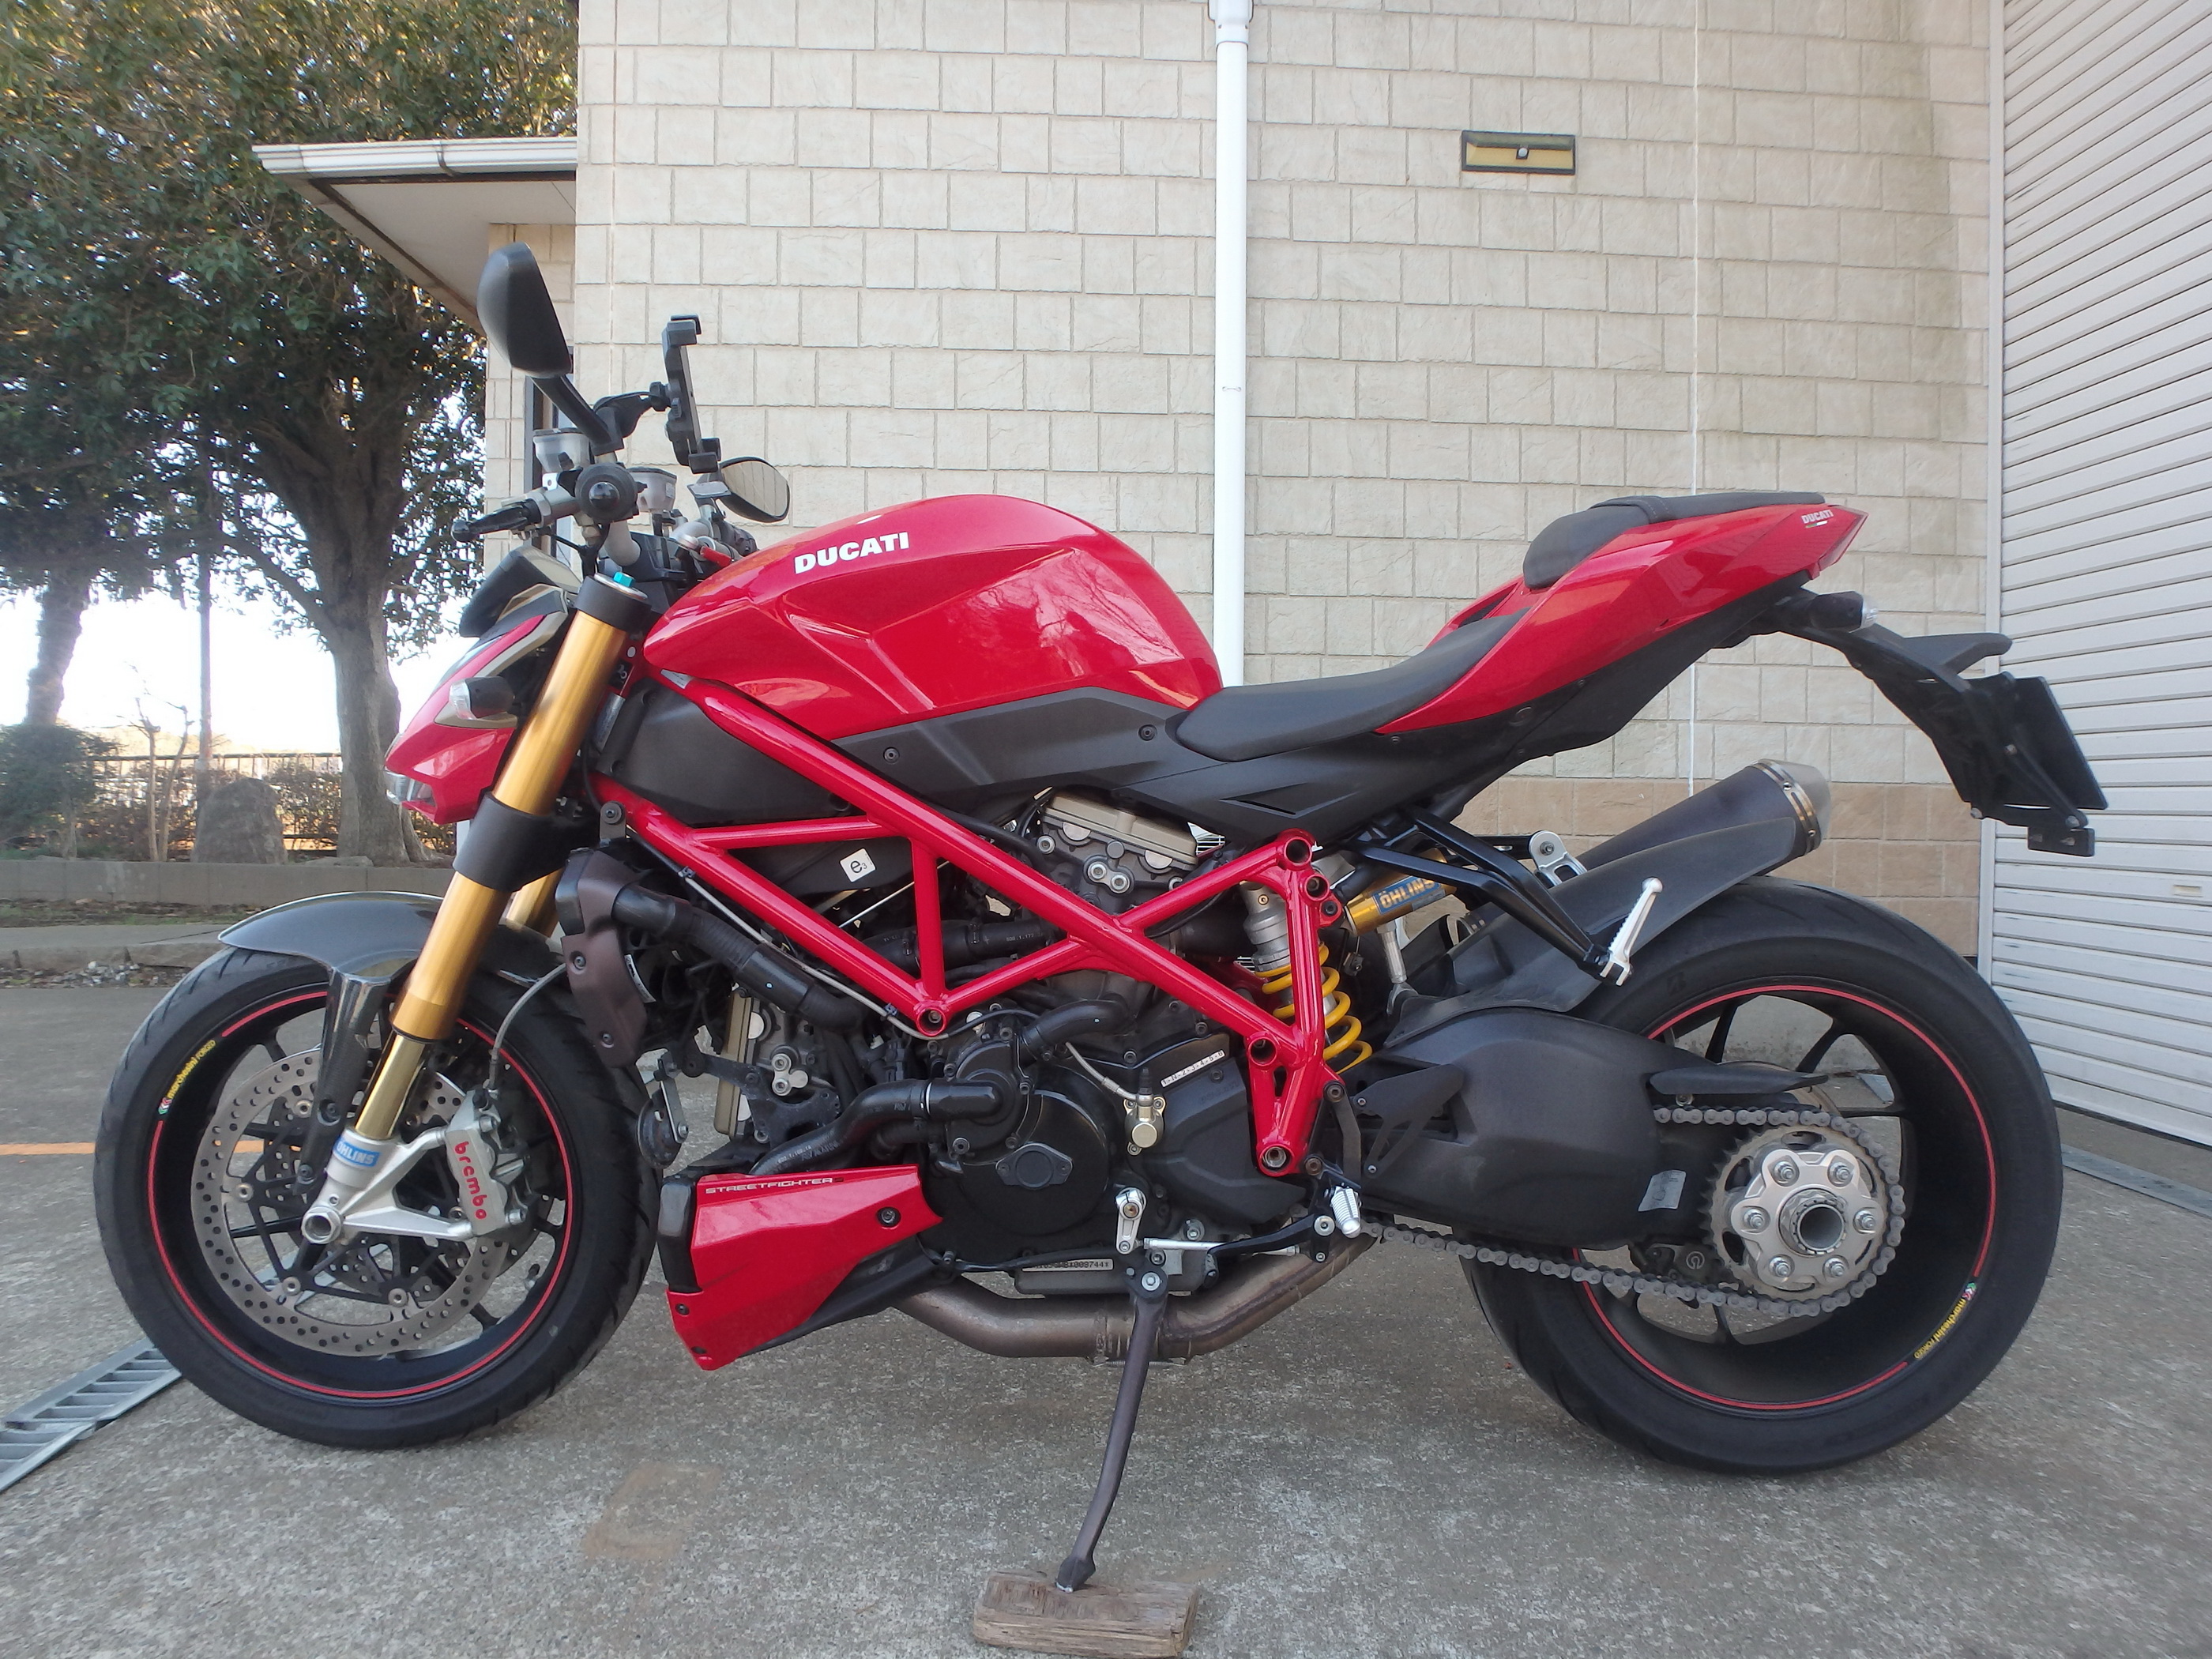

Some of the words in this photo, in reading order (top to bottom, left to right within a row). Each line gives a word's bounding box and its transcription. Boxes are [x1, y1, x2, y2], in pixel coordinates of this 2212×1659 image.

[1800, 509, 1834, 524] DUCATI
[794, 532, 910, 574] DUCATI
[1379, 878, 1435, 908] ÖHLINS
[167, 1056, 198, 1099] marchesini
[454, 1141, 488, 1220] brembo
[705, 1177, 833, 1194] STREETFIGHTER
[1933, 1298, 1967, 1342] marchesini
